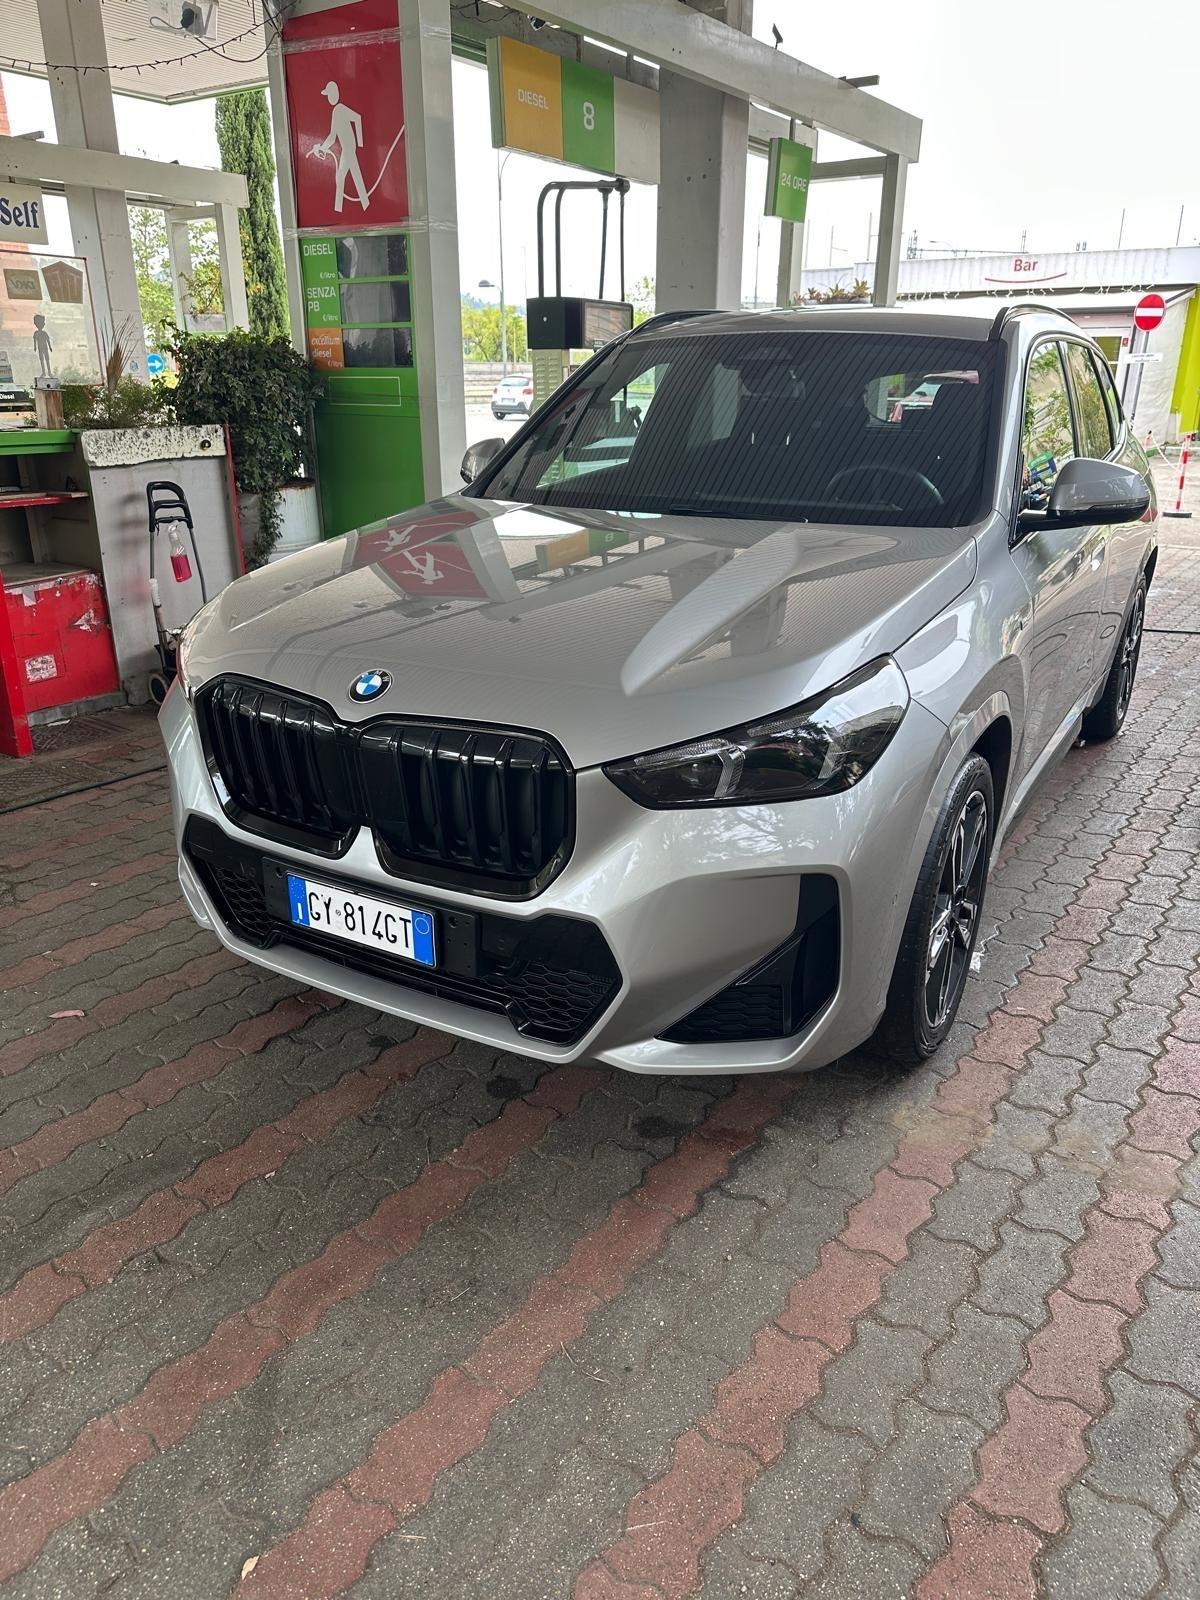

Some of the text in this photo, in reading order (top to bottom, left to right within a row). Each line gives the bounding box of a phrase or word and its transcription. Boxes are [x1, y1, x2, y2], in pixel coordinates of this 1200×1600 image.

[517, 88, 549, 110] DIESEL
[583, 101, 595, 131] 8
[781, 172, 807, 192] 24 ORE
[0, 197, 39, 229] Self
[303, 244, 333, 256] DIESEL
[1013, 258, 1039, 272] Bar
[307, 287, 336, 299] SENZA
[308, 301, 320, 312] PB
[312, 348, 332, 358] diesel
[343, 901, 412, 949] 814GT
